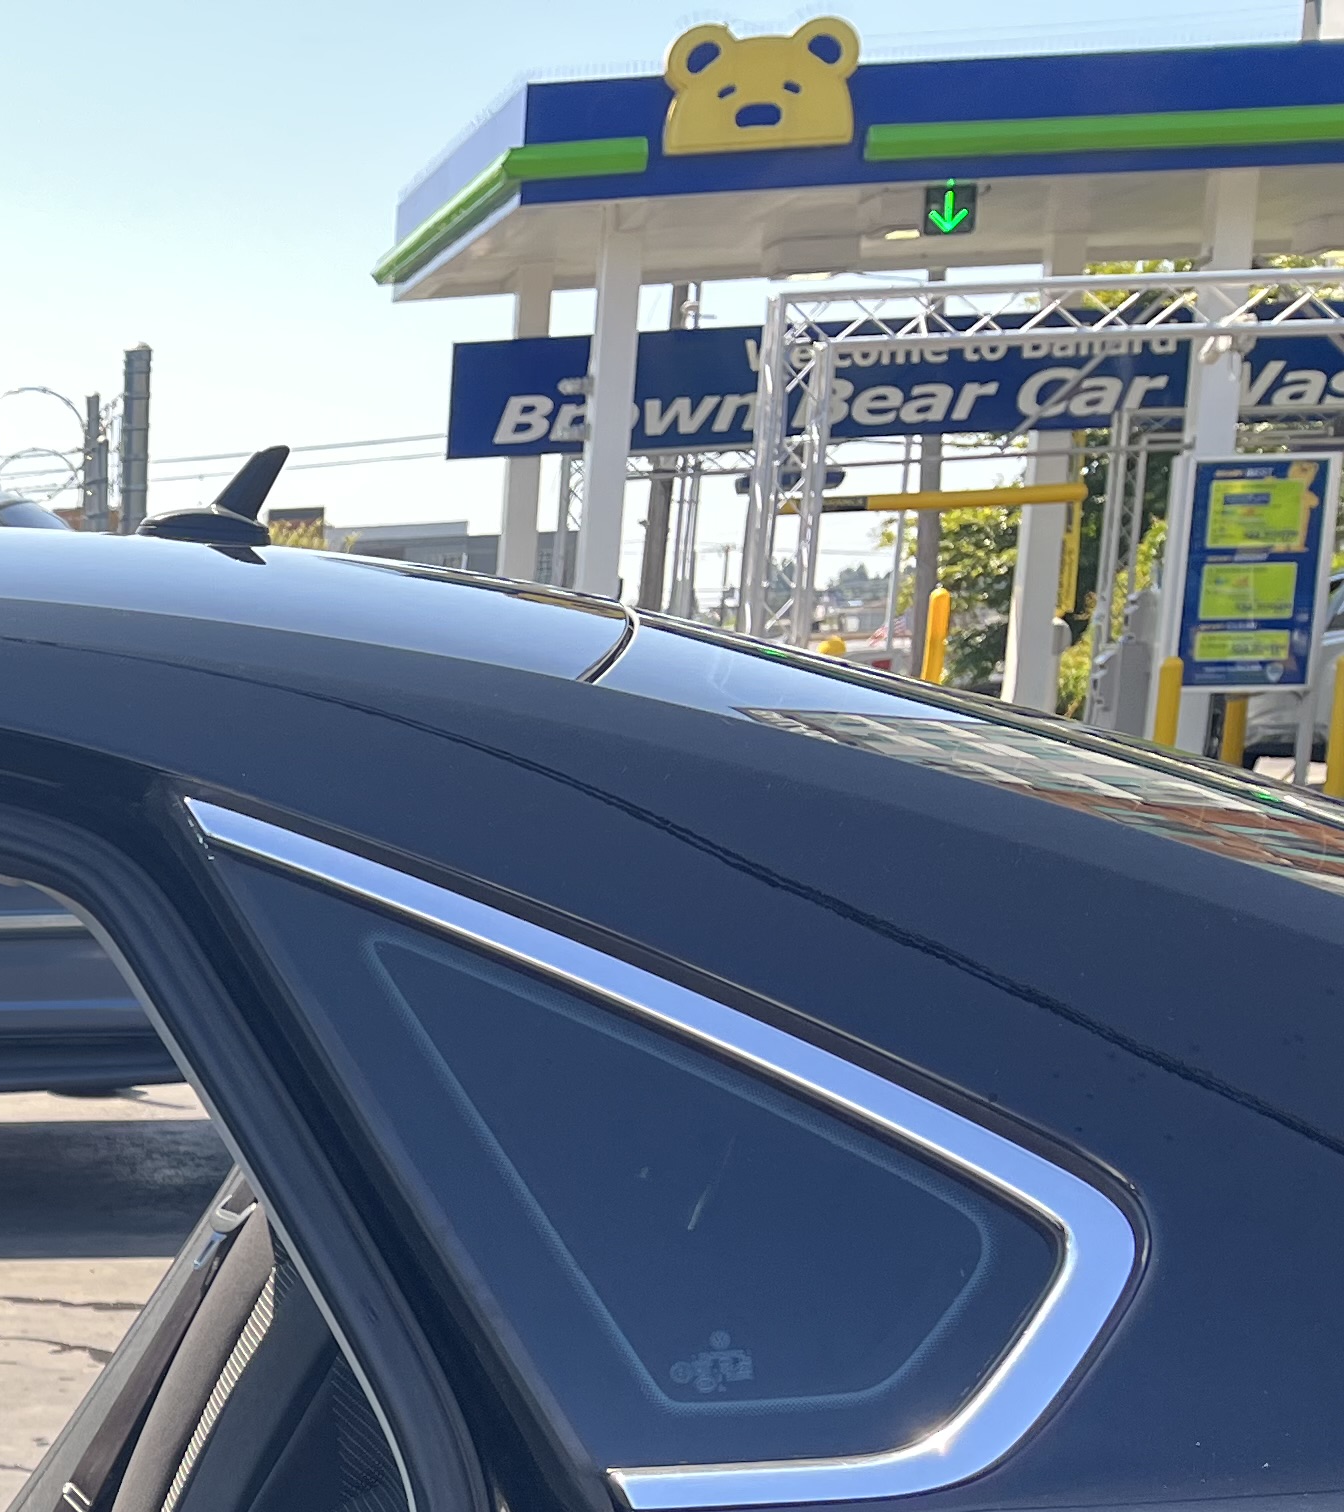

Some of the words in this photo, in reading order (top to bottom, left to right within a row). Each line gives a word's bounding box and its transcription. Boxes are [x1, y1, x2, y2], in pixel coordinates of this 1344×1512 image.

[492, 391, 760, 445] Brwn
[791, 378, 1001, 429] Bear
[1016, 366, 1169, 419] Car
